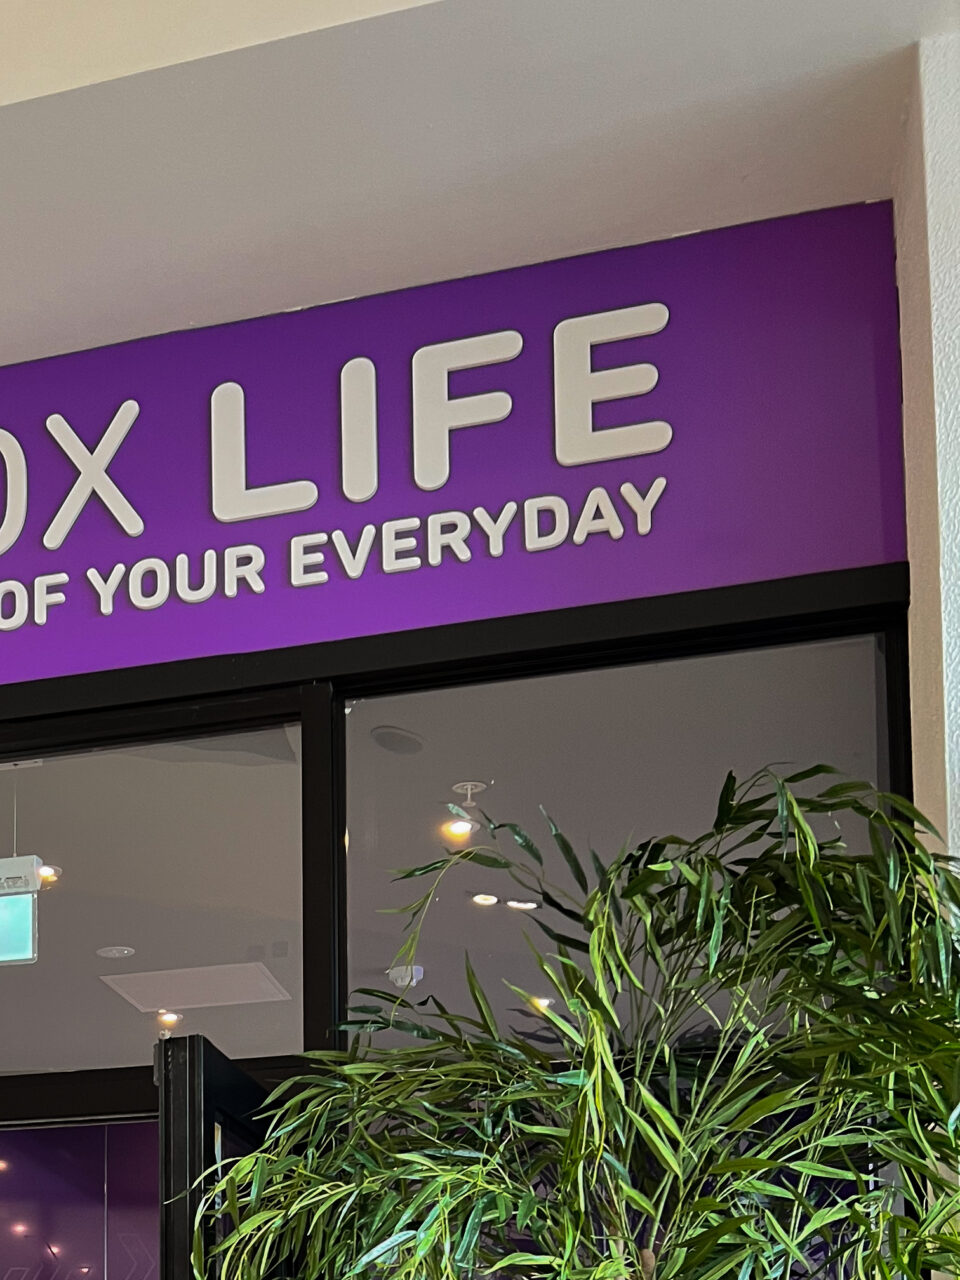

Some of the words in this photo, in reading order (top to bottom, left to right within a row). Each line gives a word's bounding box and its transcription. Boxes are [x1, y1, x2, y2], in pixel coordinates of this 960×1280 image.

[209, 301, 674, 524] LIFE
[85, 543, 267, 617] YOUR
[289, 475, 668, 589] EVERYDAY
